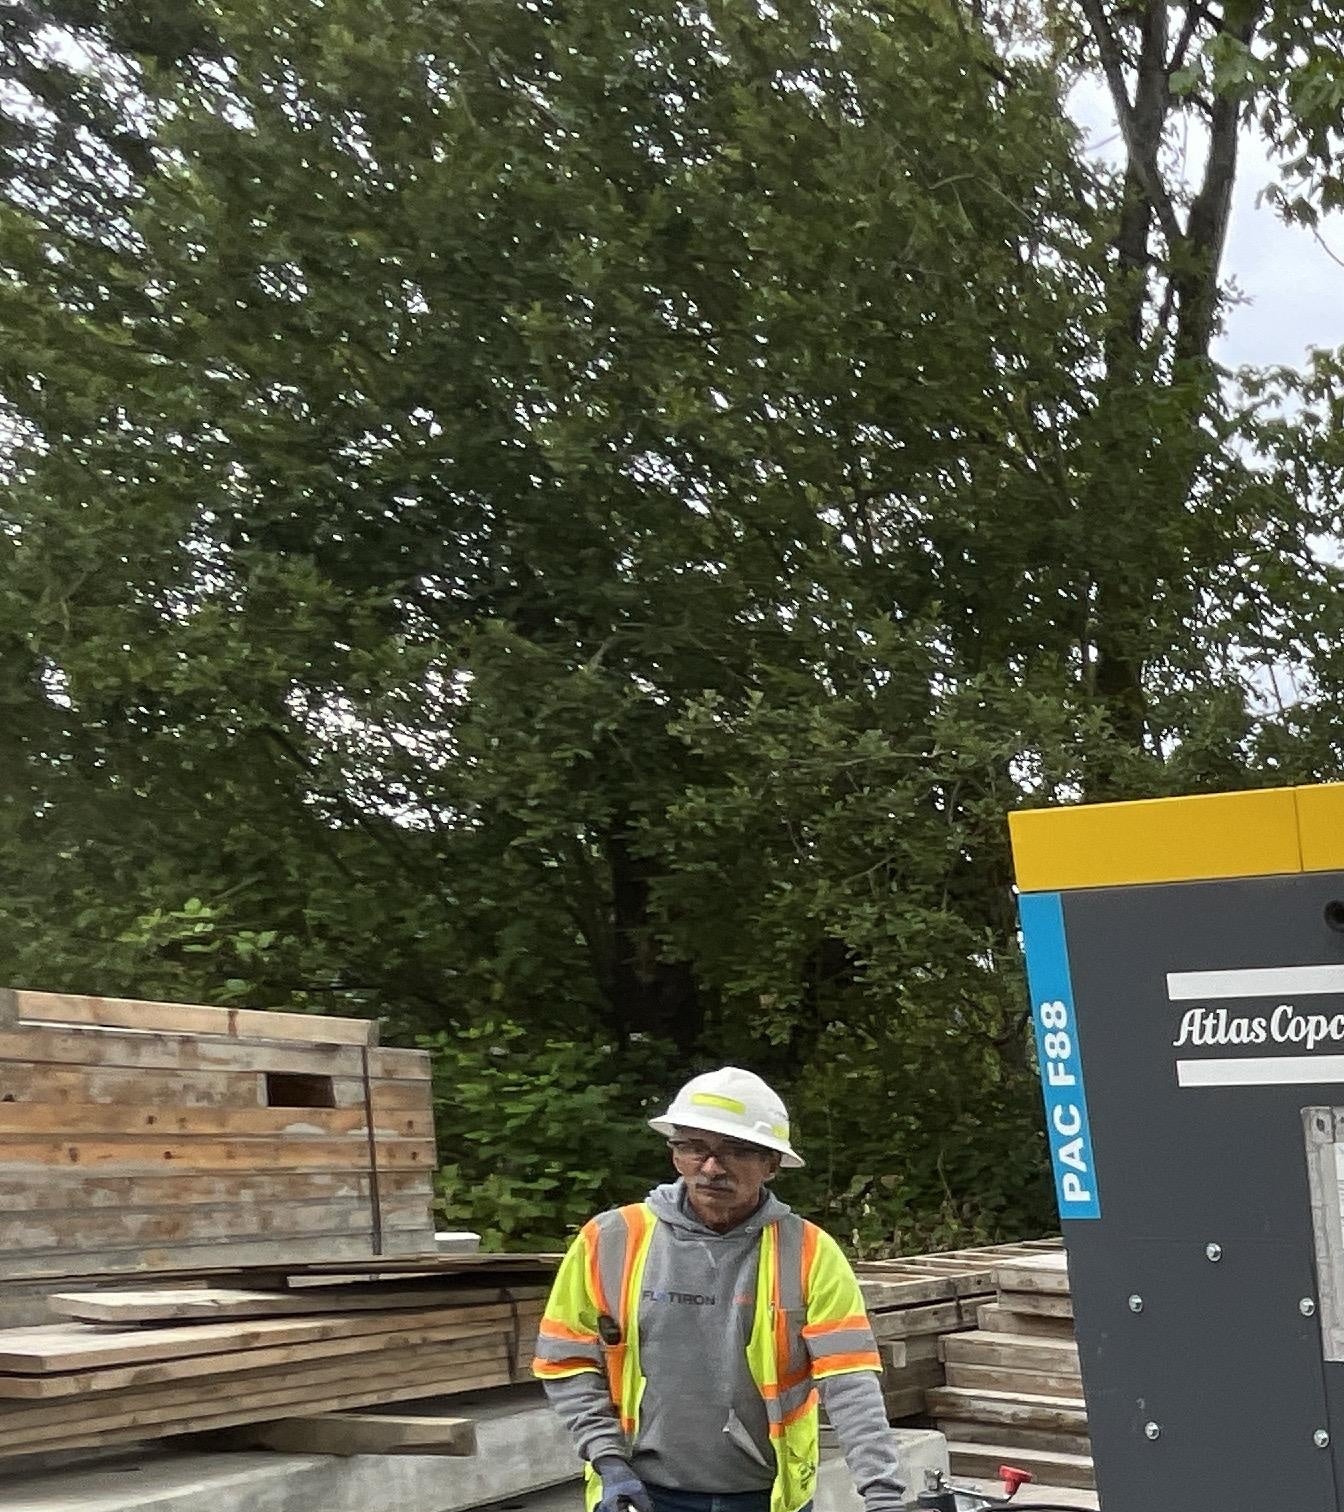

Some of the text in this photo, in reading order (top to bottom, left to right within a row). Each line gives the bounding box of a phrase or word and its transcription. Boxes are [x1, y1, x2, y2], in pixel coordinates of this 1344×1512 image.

[1173, 1007, 1267, 1047] Atlas
[1040, 1001, 1092, 1202] PAC F88
